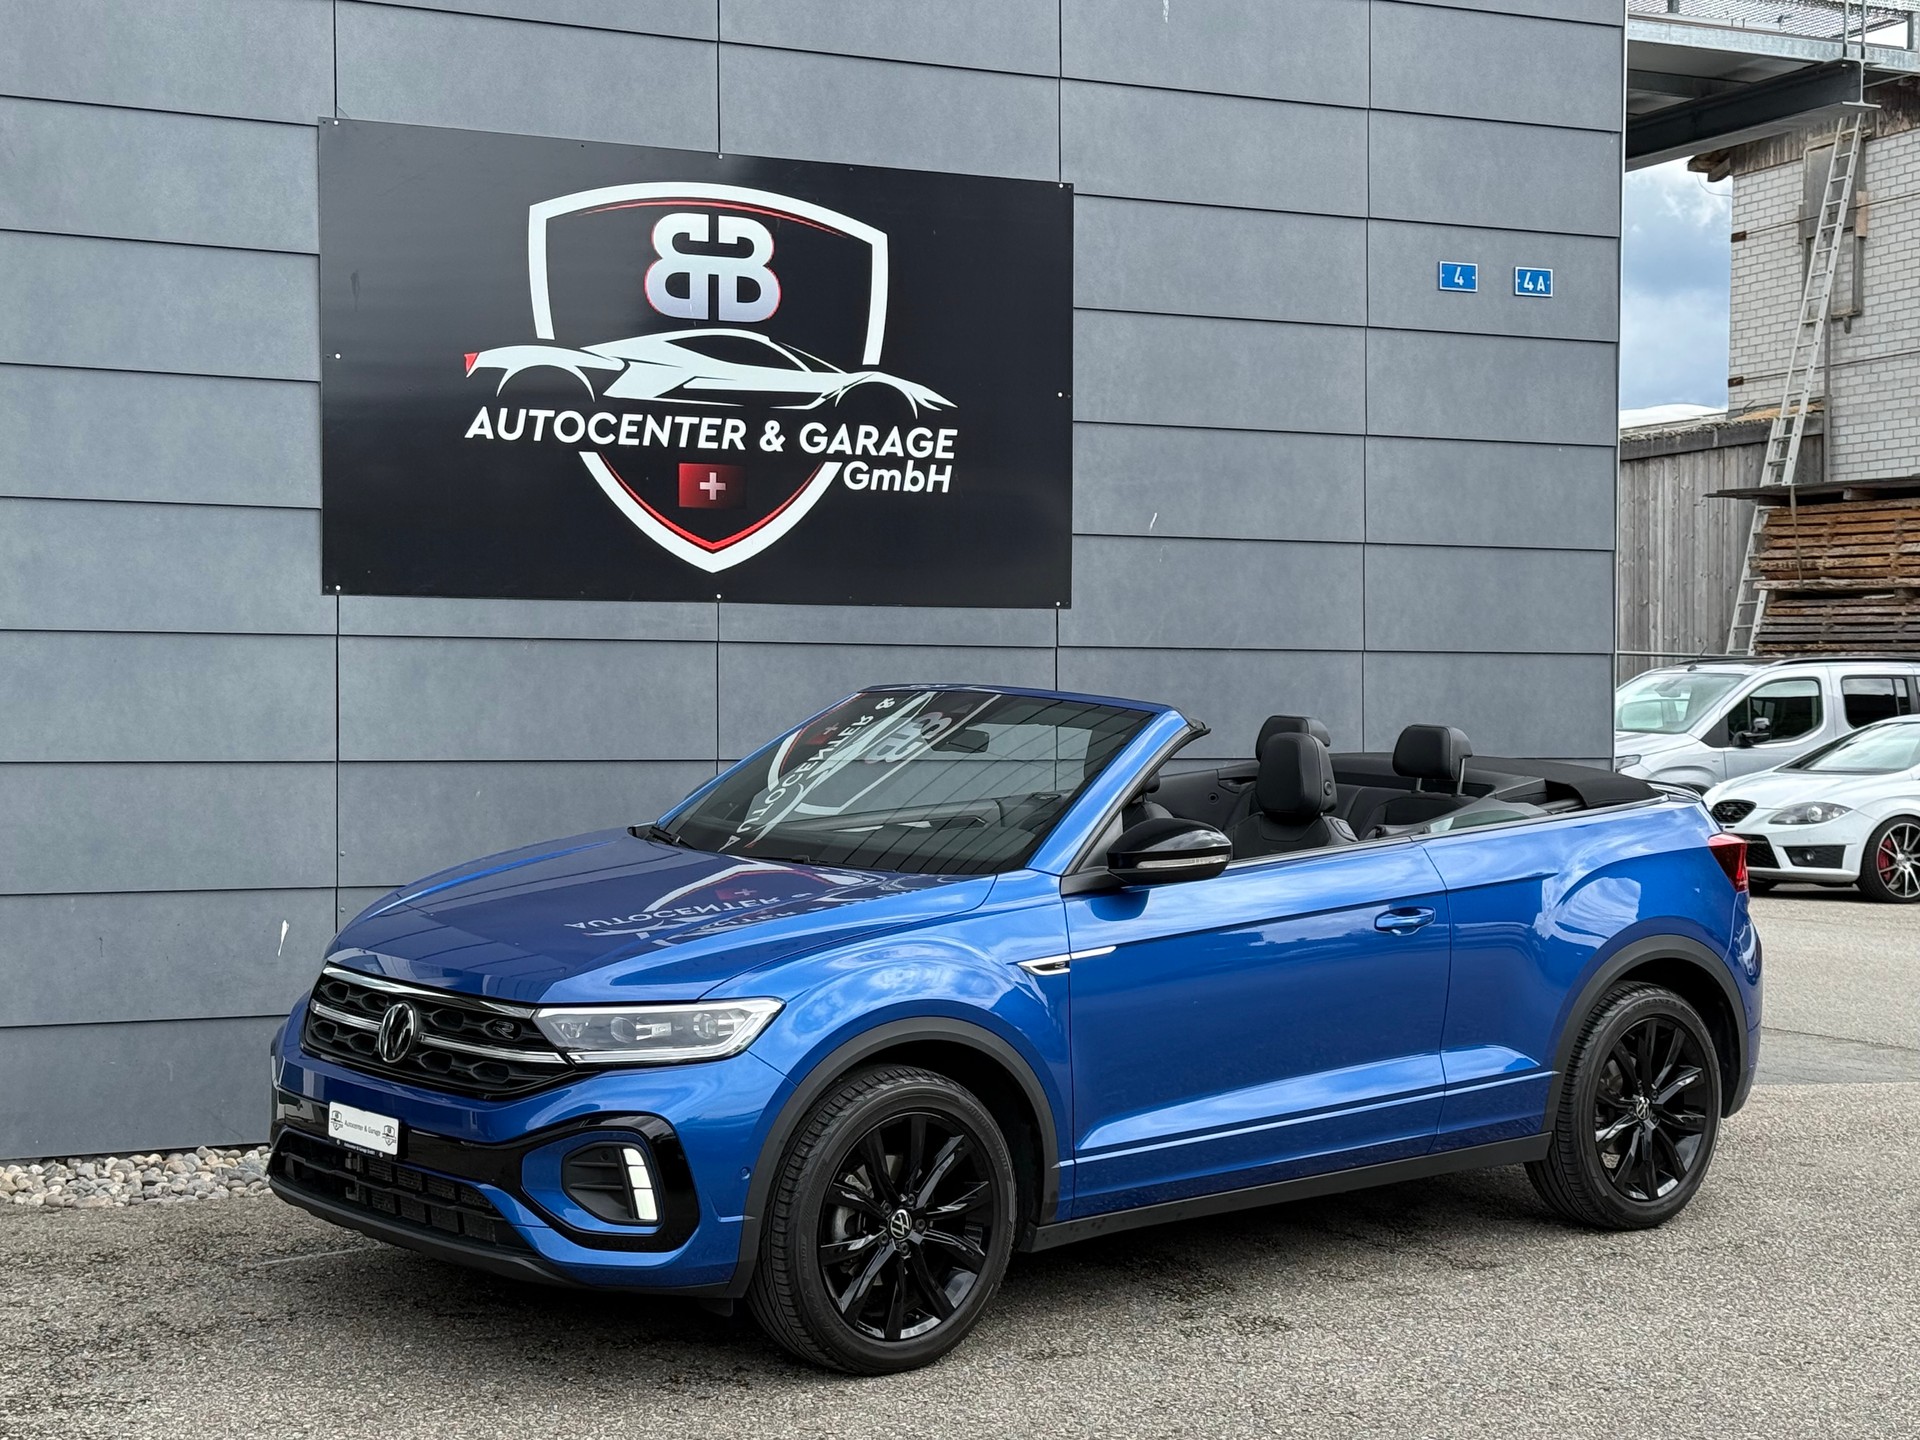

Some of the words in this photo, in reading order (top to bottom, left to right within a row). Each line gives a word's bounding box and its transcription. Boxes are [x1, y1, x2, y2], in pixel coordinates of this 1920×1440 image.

[1453, 266, 1465, 286] 4
[1523, 271, 1546, 292] 4A
[464, 405, 747, 452] AUTOCENTER
[759, 420, 787, 453] &
[799, 423, 959, 460] GARAGE
[842, 461, 952, 494] GmbH
